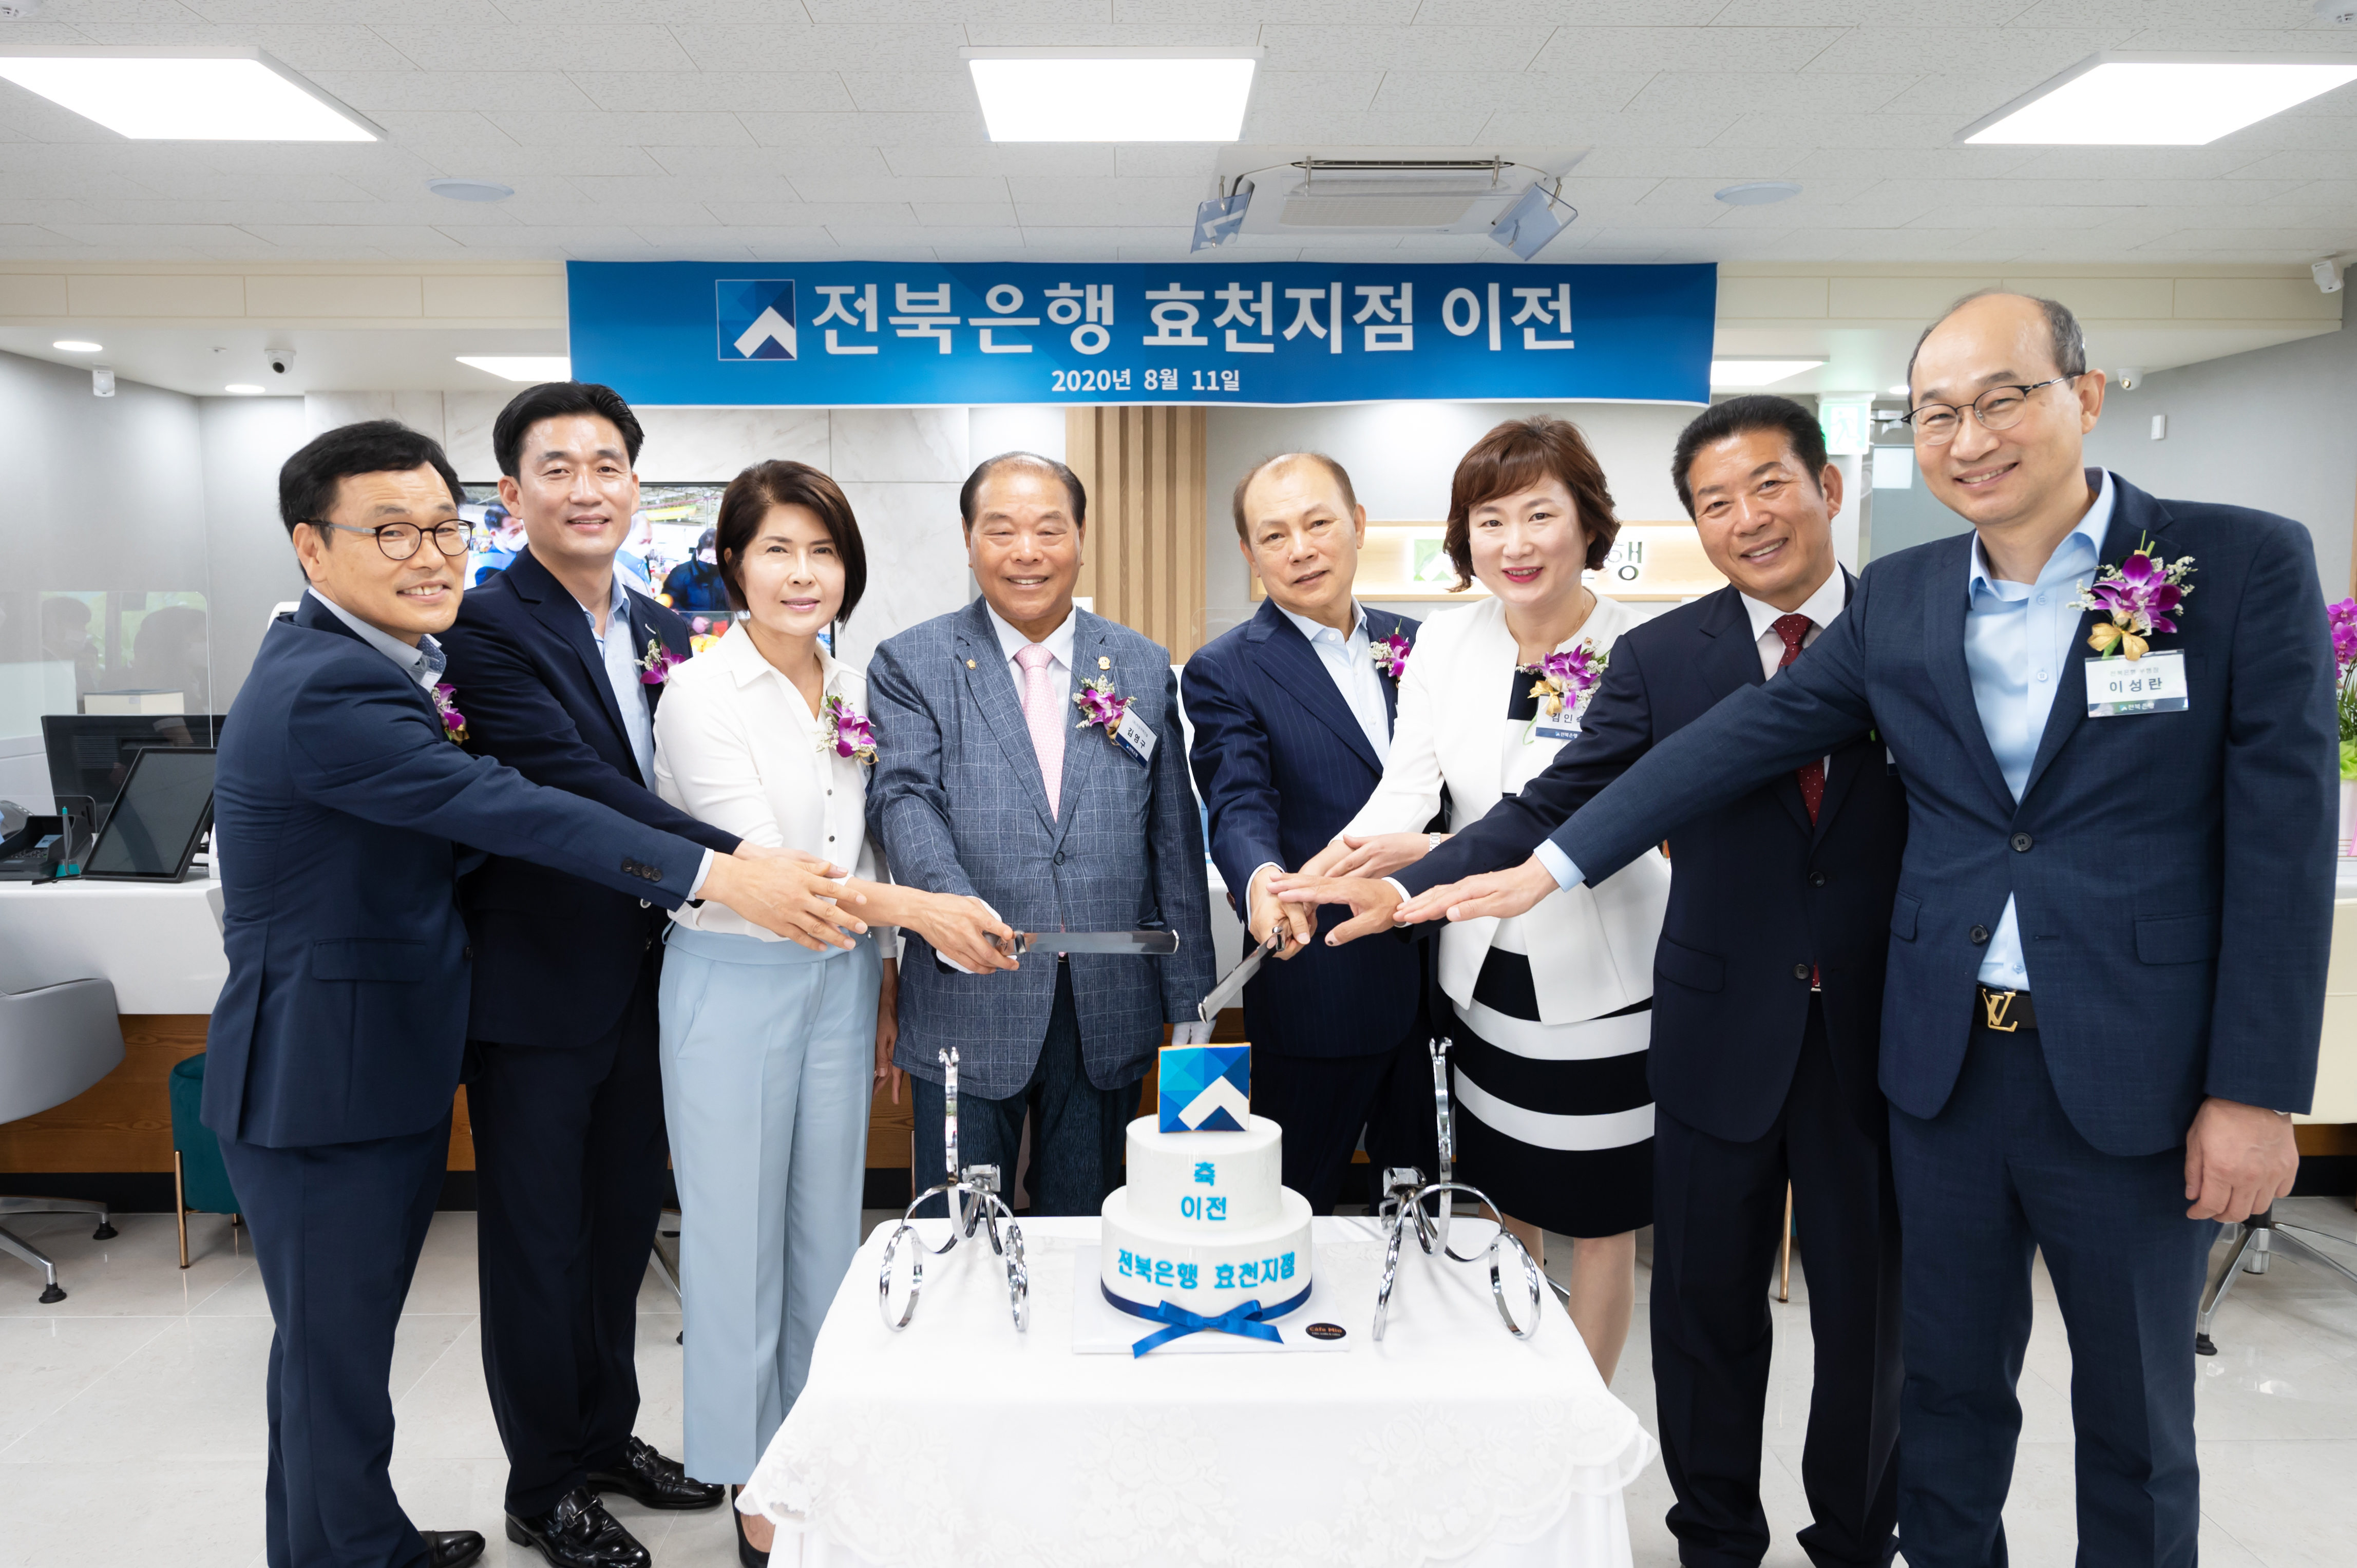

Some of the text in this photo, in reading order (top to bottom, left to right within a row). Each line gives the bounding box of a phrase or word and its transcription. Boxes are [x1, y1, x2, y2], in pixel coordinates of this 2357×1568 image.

[812, 282, 1575, 355] 전북은행 효천지점 이전
[1051, 368, 1240, 392] 2020년 8월 11일
[2109, 677, 2162, 693] 이성란
[1128, 728, 1146, 749] 김영구
[1194, 1161, 1215, 1187] 축
[1181, 1195, 1227, 1221] 이전
[1117, 1248, 1296, 1290] 전북은행 효천지점
